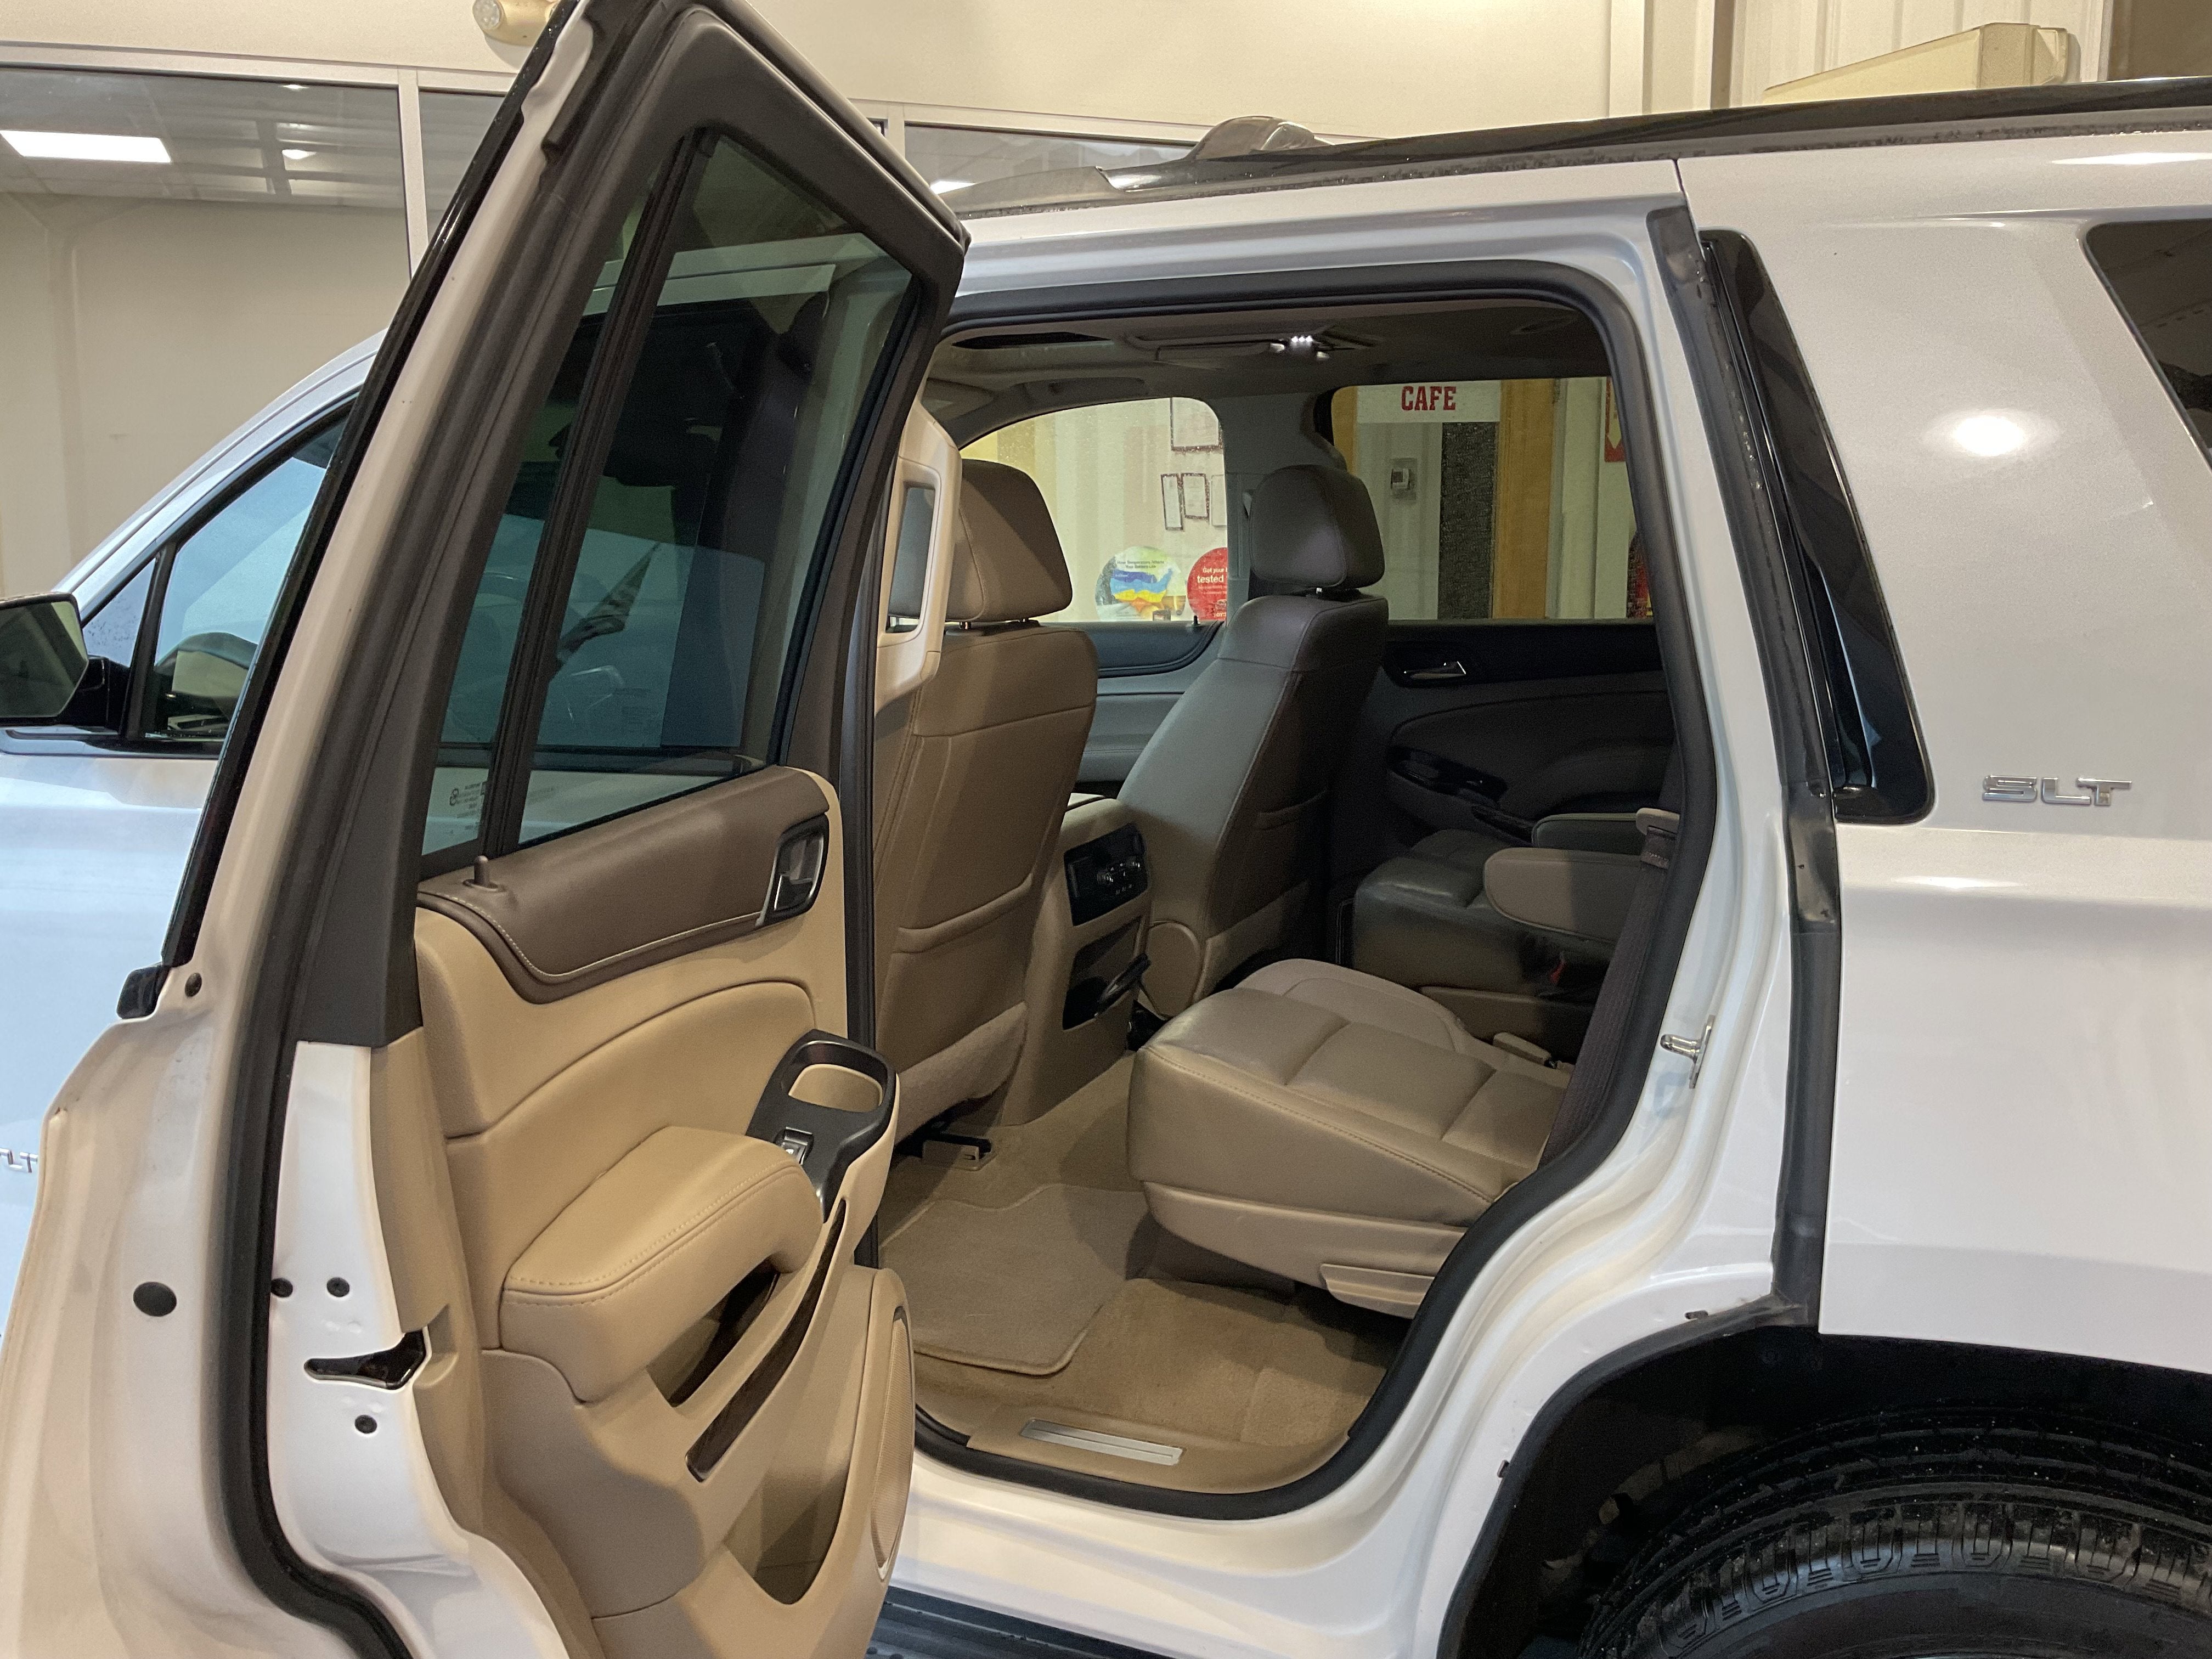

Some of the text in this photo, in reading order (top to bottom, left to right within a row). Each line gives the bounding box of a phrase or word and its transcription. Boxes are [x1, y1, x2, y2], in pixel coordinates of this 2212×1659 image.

[1401, 386, 1456, 411] CAFE
[1197, 575, 1224, 584] tested
[1982, 774, 2132, 806] SLT
